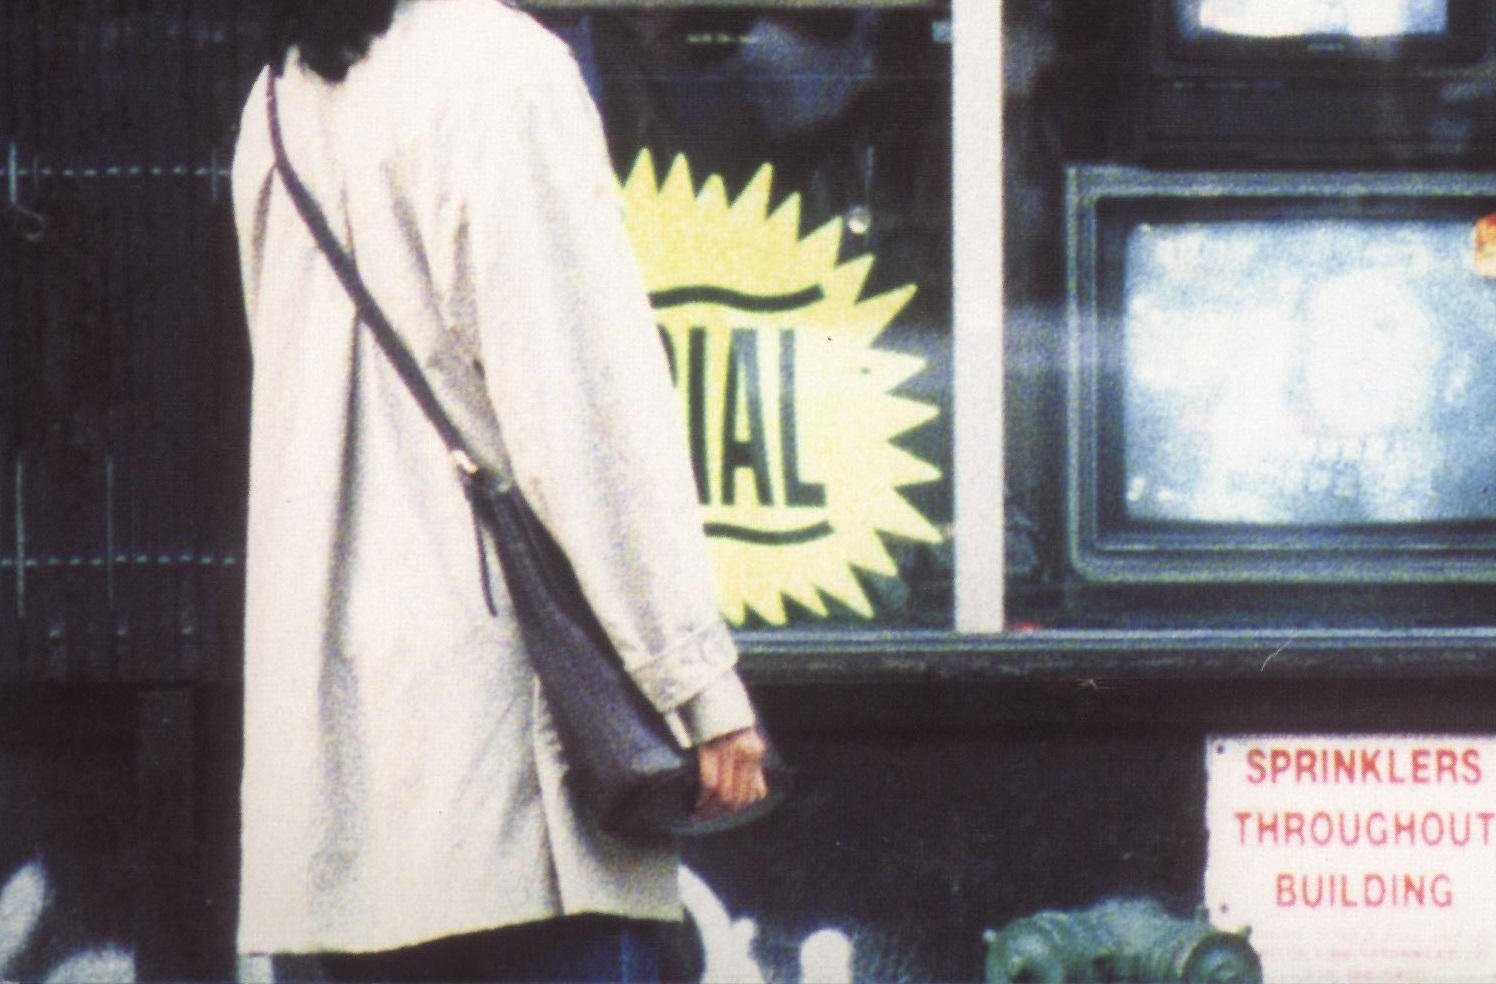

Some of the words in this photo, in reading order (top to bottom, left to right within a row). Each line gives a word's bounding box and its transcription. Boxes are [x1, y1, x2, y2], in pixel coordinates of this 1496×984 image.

[656, 323, 826, 507] IAL
[1246, 747, 1483, 786] SPRINKLERS
[1234, 811, 1496, 847] THROUGHOUT
[1275, 872, 1454, 909] BUILDING
